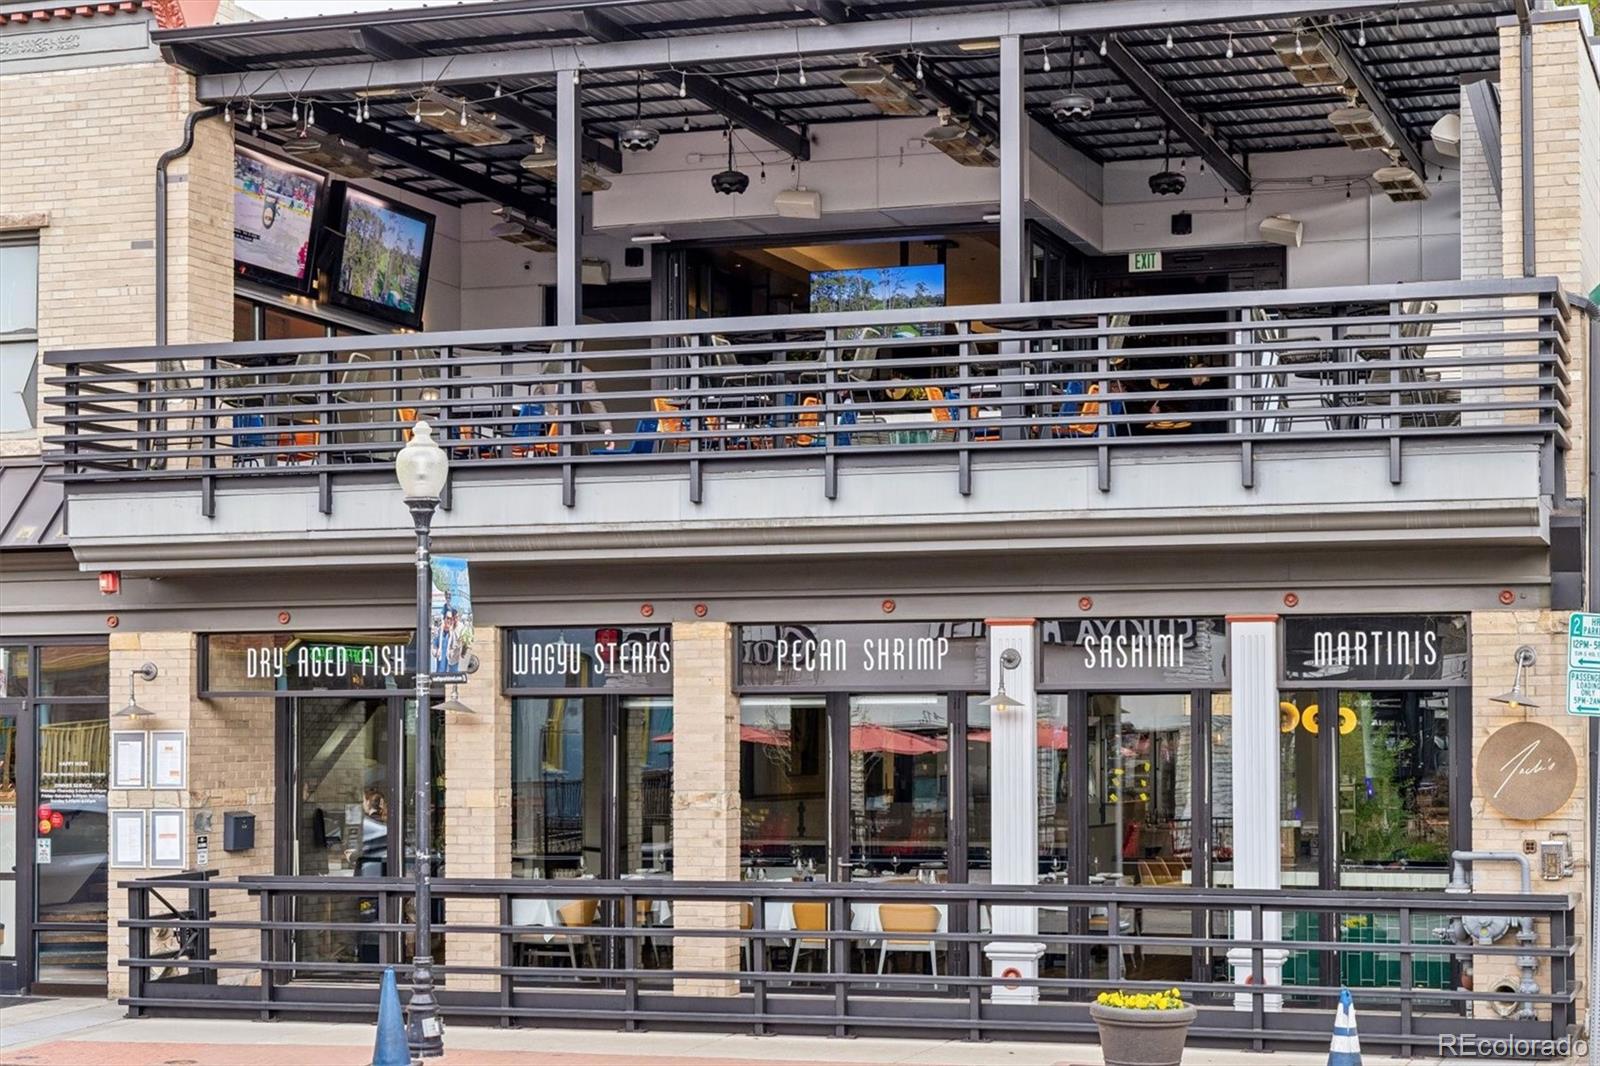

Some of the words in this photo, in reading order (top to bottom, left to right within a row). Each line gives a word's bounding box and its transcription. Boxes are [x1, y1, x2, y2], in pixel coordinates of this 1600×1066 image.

[1135, 253, 1156, 270] EXIT
[1573, 617, 1581, 635] 2
[247, 647, 284, 678] DRY
[298, 646, 347, 678] AGED
[361, 645, 405, 677] FISH
[512, 642, 581, 675] WAGYU
[594, 642, 671, 675] STEAKS
[777, 638, 847, 672] PECAN
[863, 637, 949, 671] SHRIMP
[1084, 634, 1184, 669] SASHIMI
[1314, 630, 1437, 666] MARTINIS
[1581, 689, 1595, 697] ONLY
